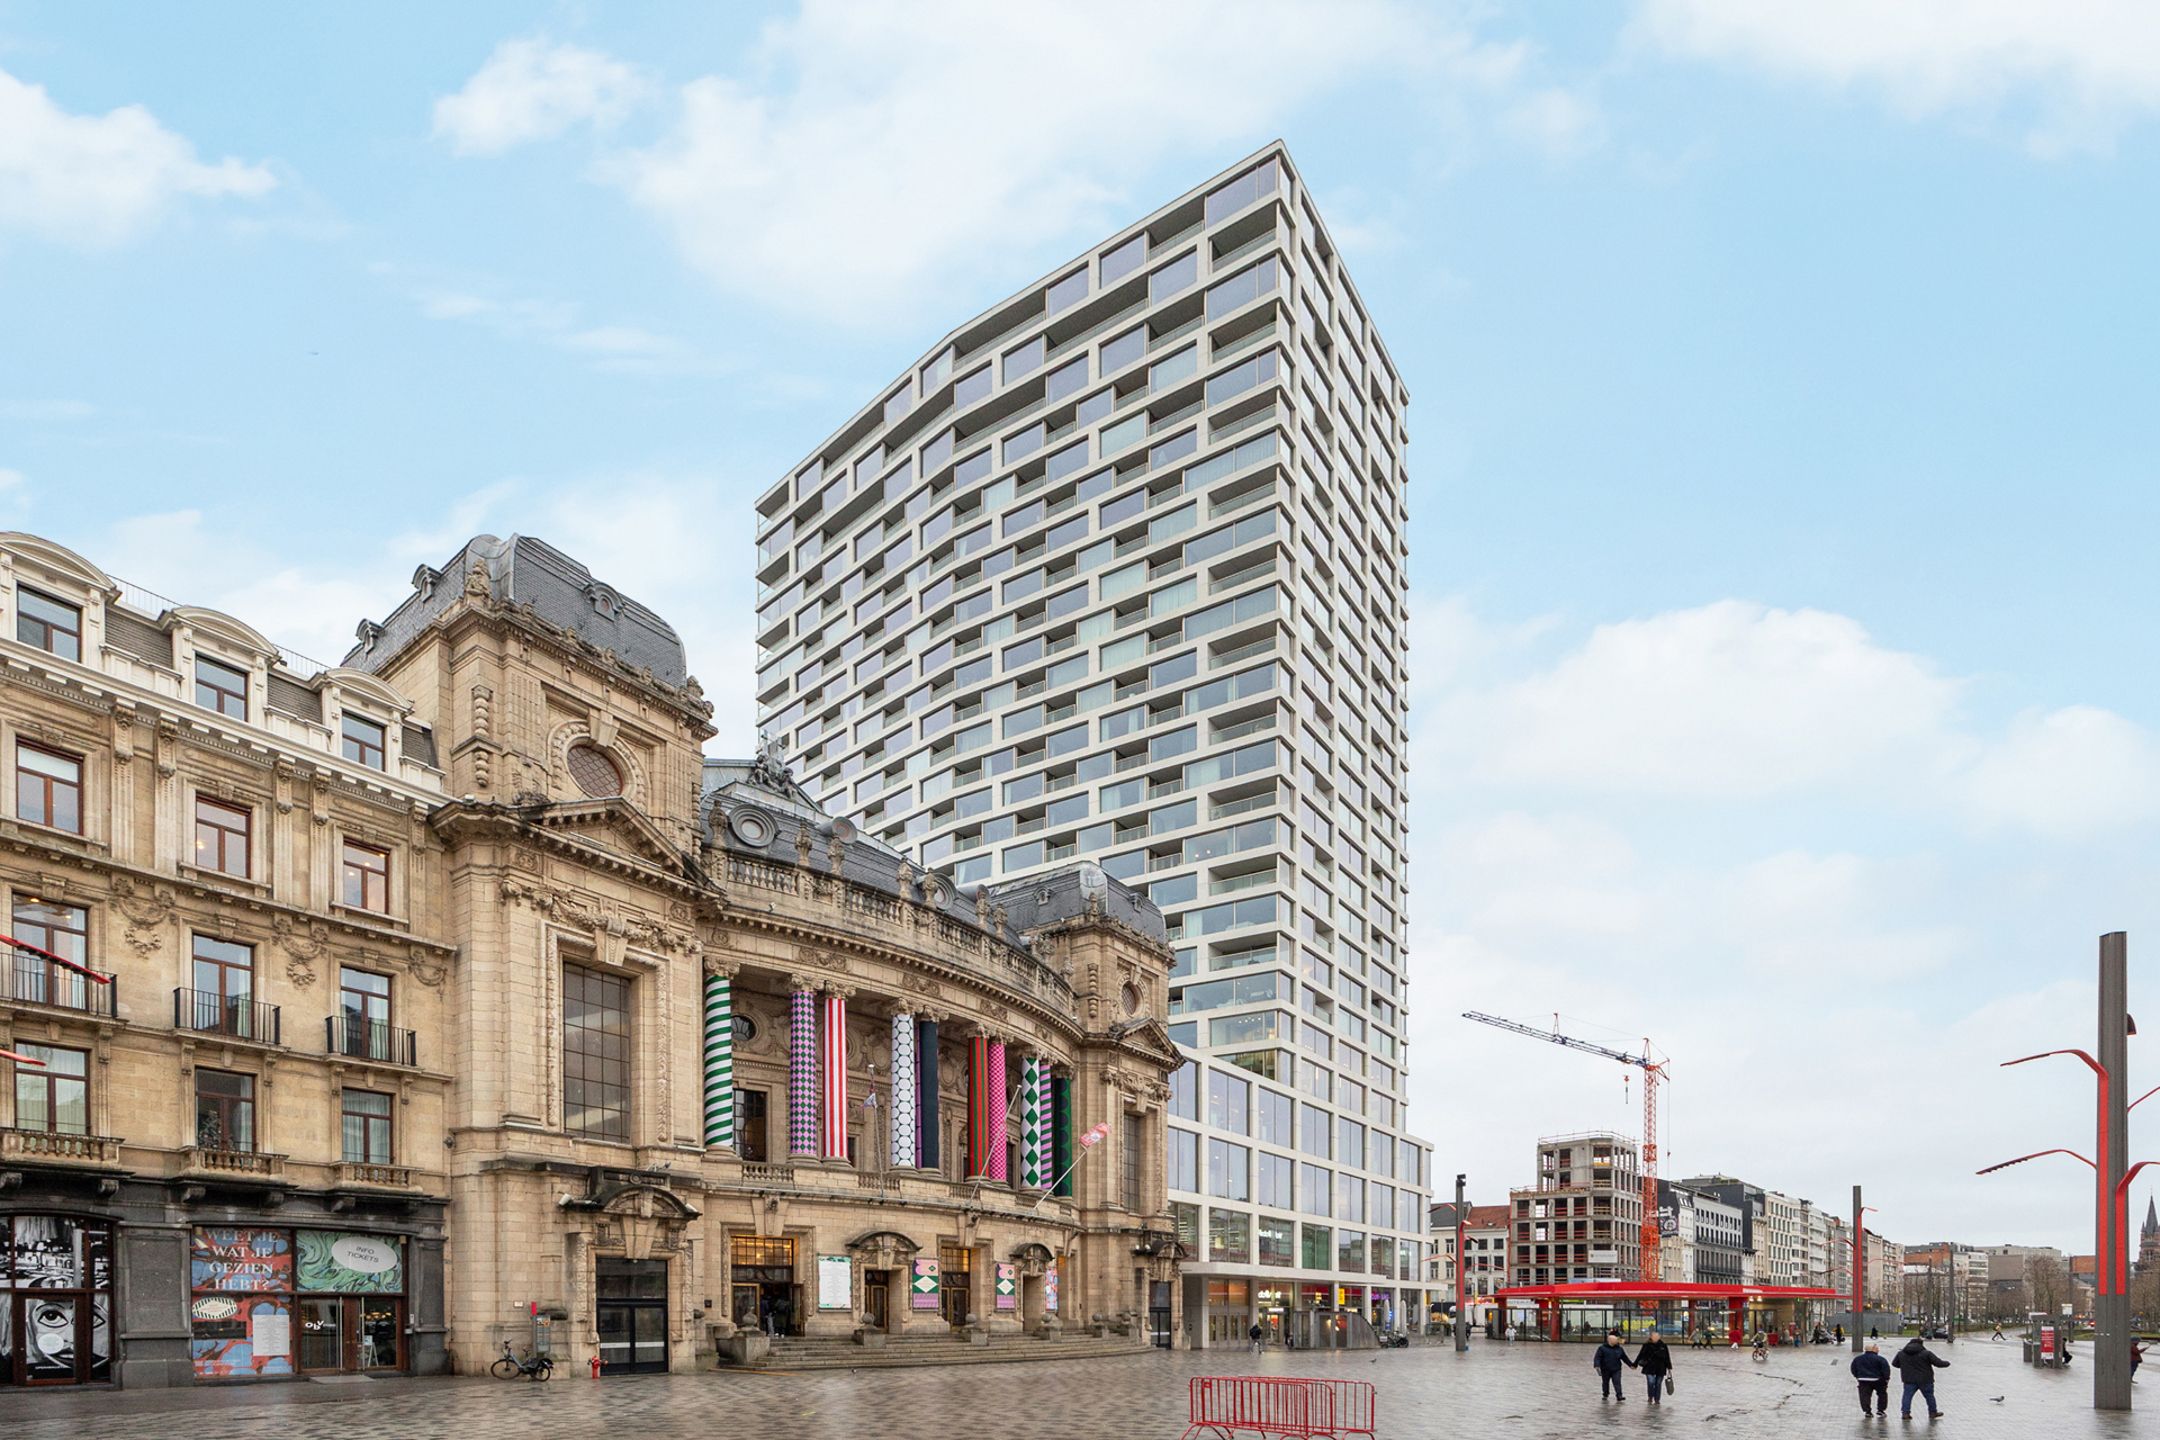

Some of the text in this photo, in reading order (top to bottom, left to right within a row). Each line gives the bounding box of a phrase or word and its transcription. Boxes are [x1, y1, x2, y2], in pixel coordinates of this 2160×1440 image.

[206, 1229, 279, 1243] WEET JE
[212, 1245, 273, 1259] WAT JE
[356, 1246, 375, 1255] INFO
[347, 1251, 380, 1264] TICKETS
[209, 1262, 273, 1274] GEZIEN
[215, 1278, 270, 1290] HEBT?
